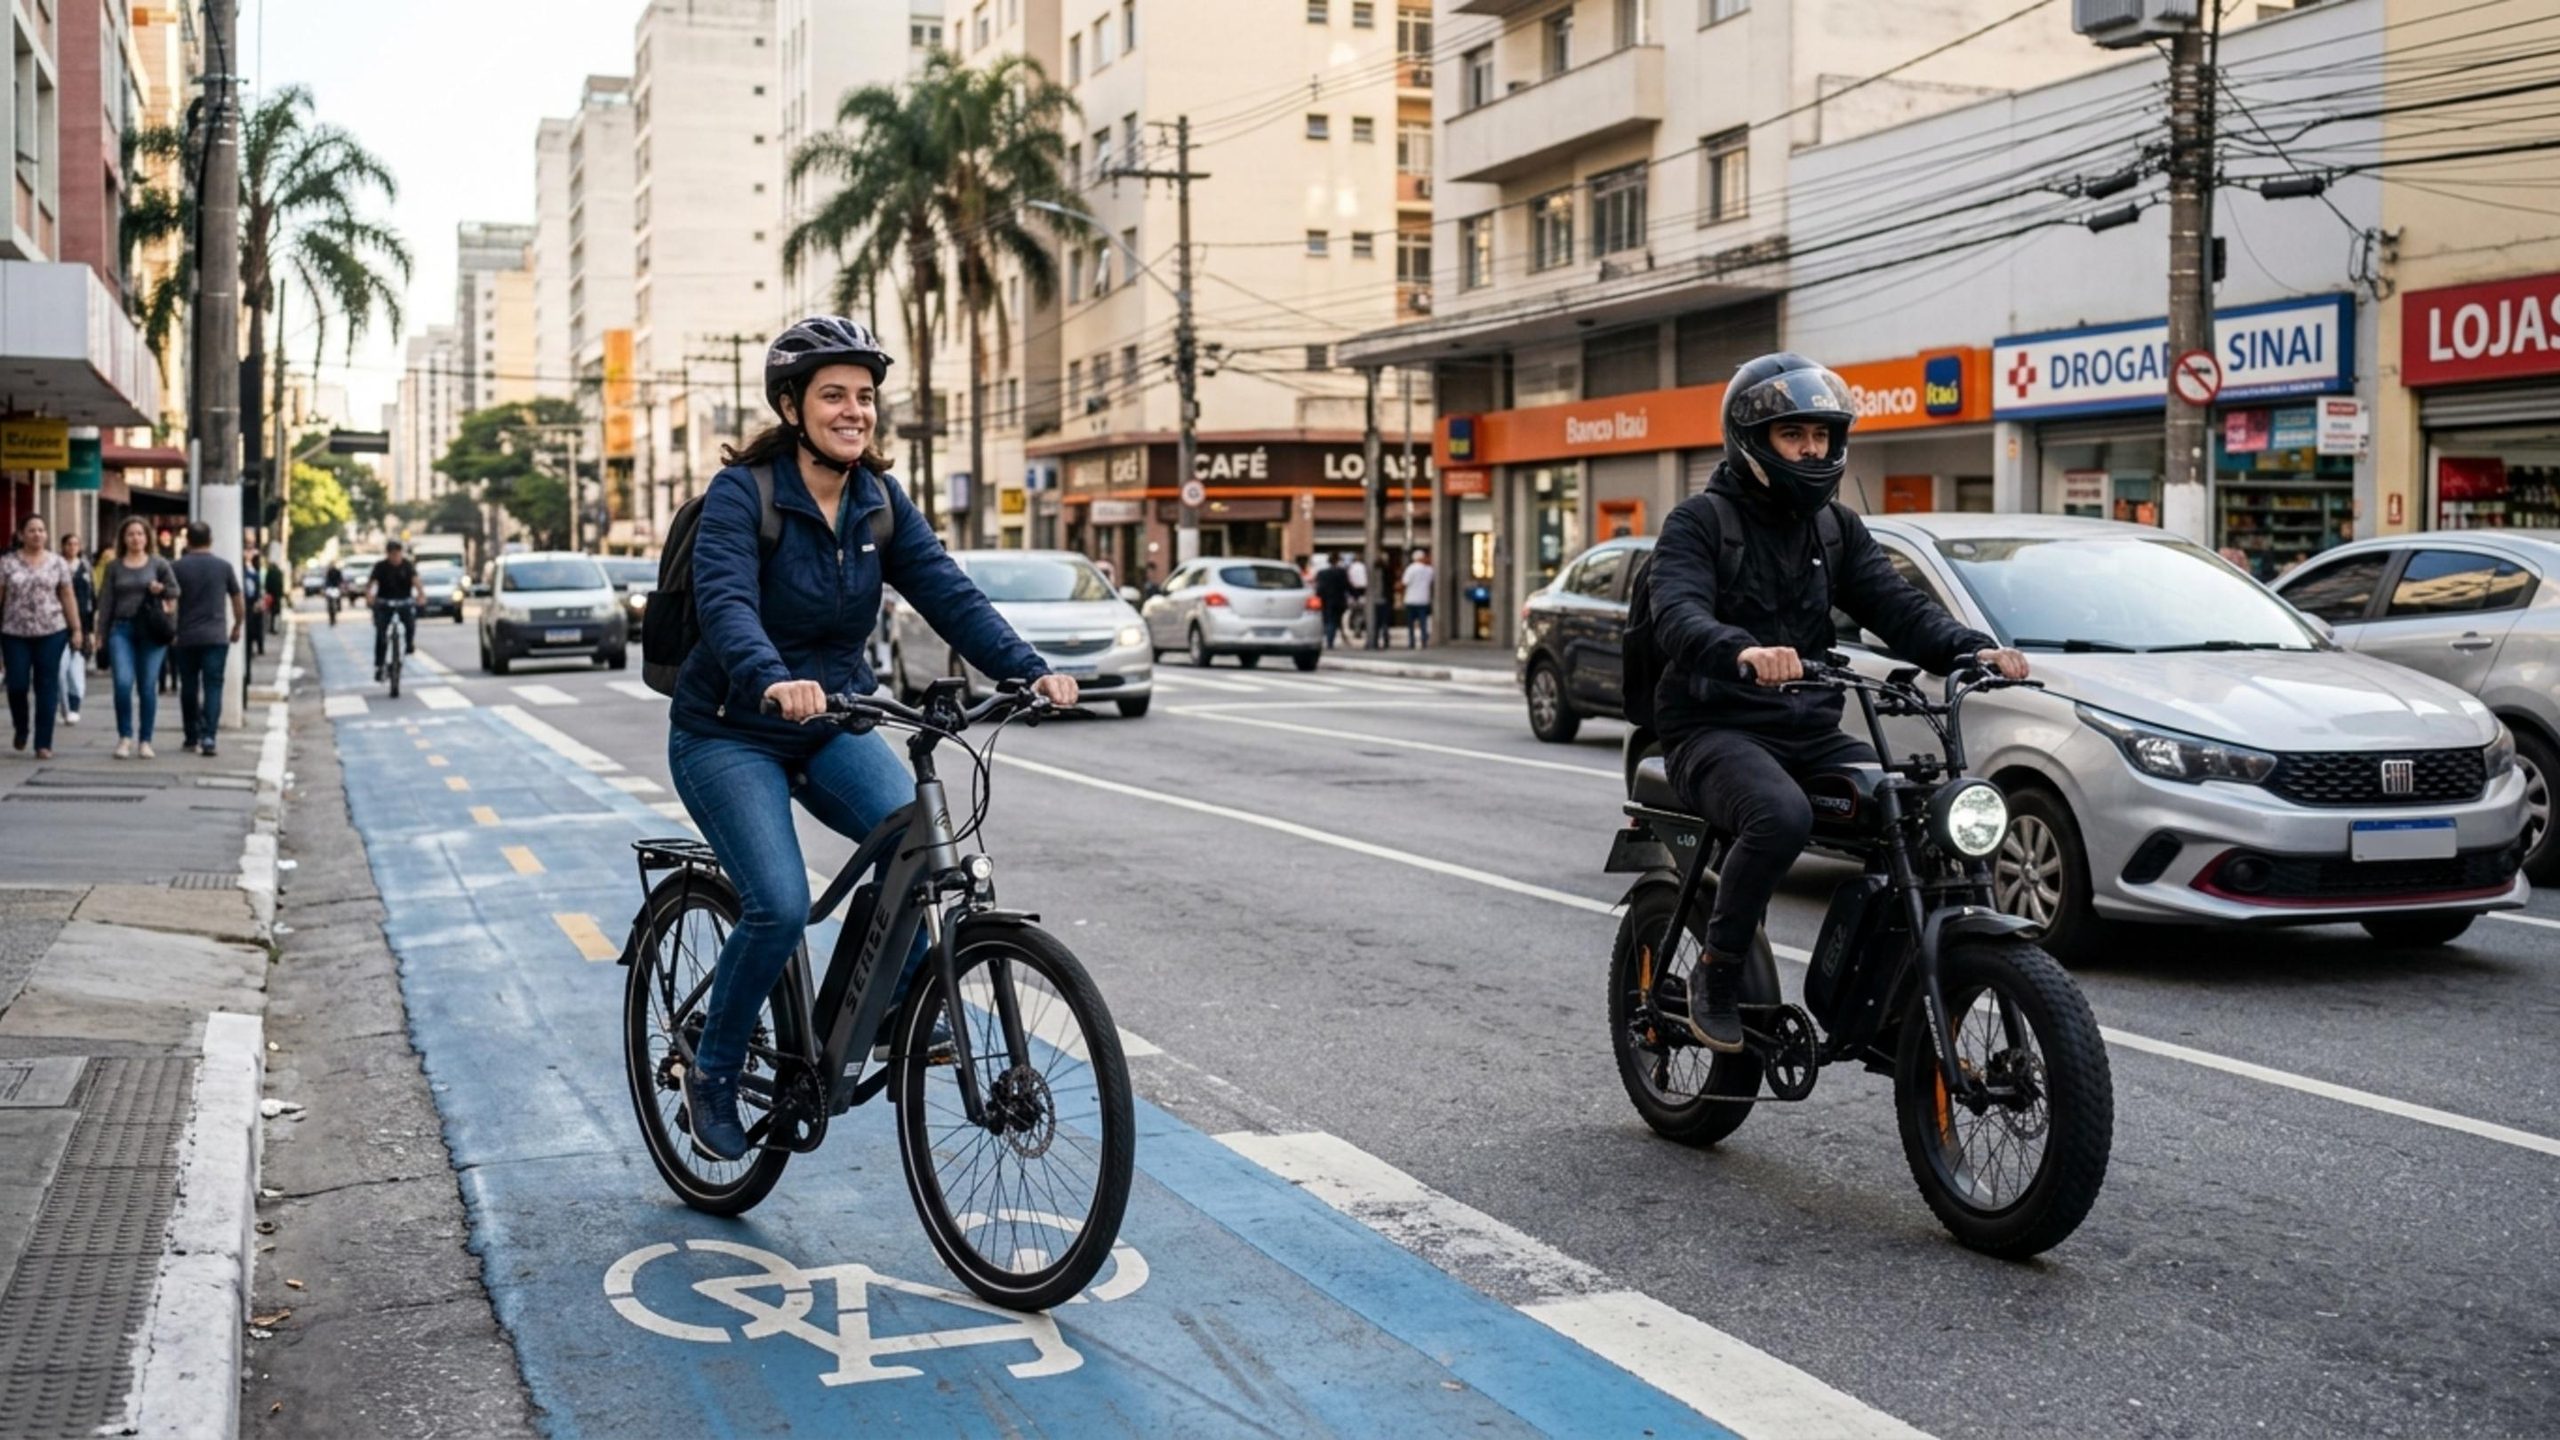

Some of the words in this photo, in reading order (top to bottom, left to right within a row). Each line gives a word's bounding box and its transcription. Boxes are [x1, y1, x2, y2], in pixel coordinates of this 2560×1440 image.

[2228, 323, 2323, 372] SINAI
[1850, 384, 1917, 418] Banco
[1566, 416, 1613, 444] Banco
[1194, 445, 1268, 479] CAFÉ
[1325, 453, 1417, 485] LOAS
